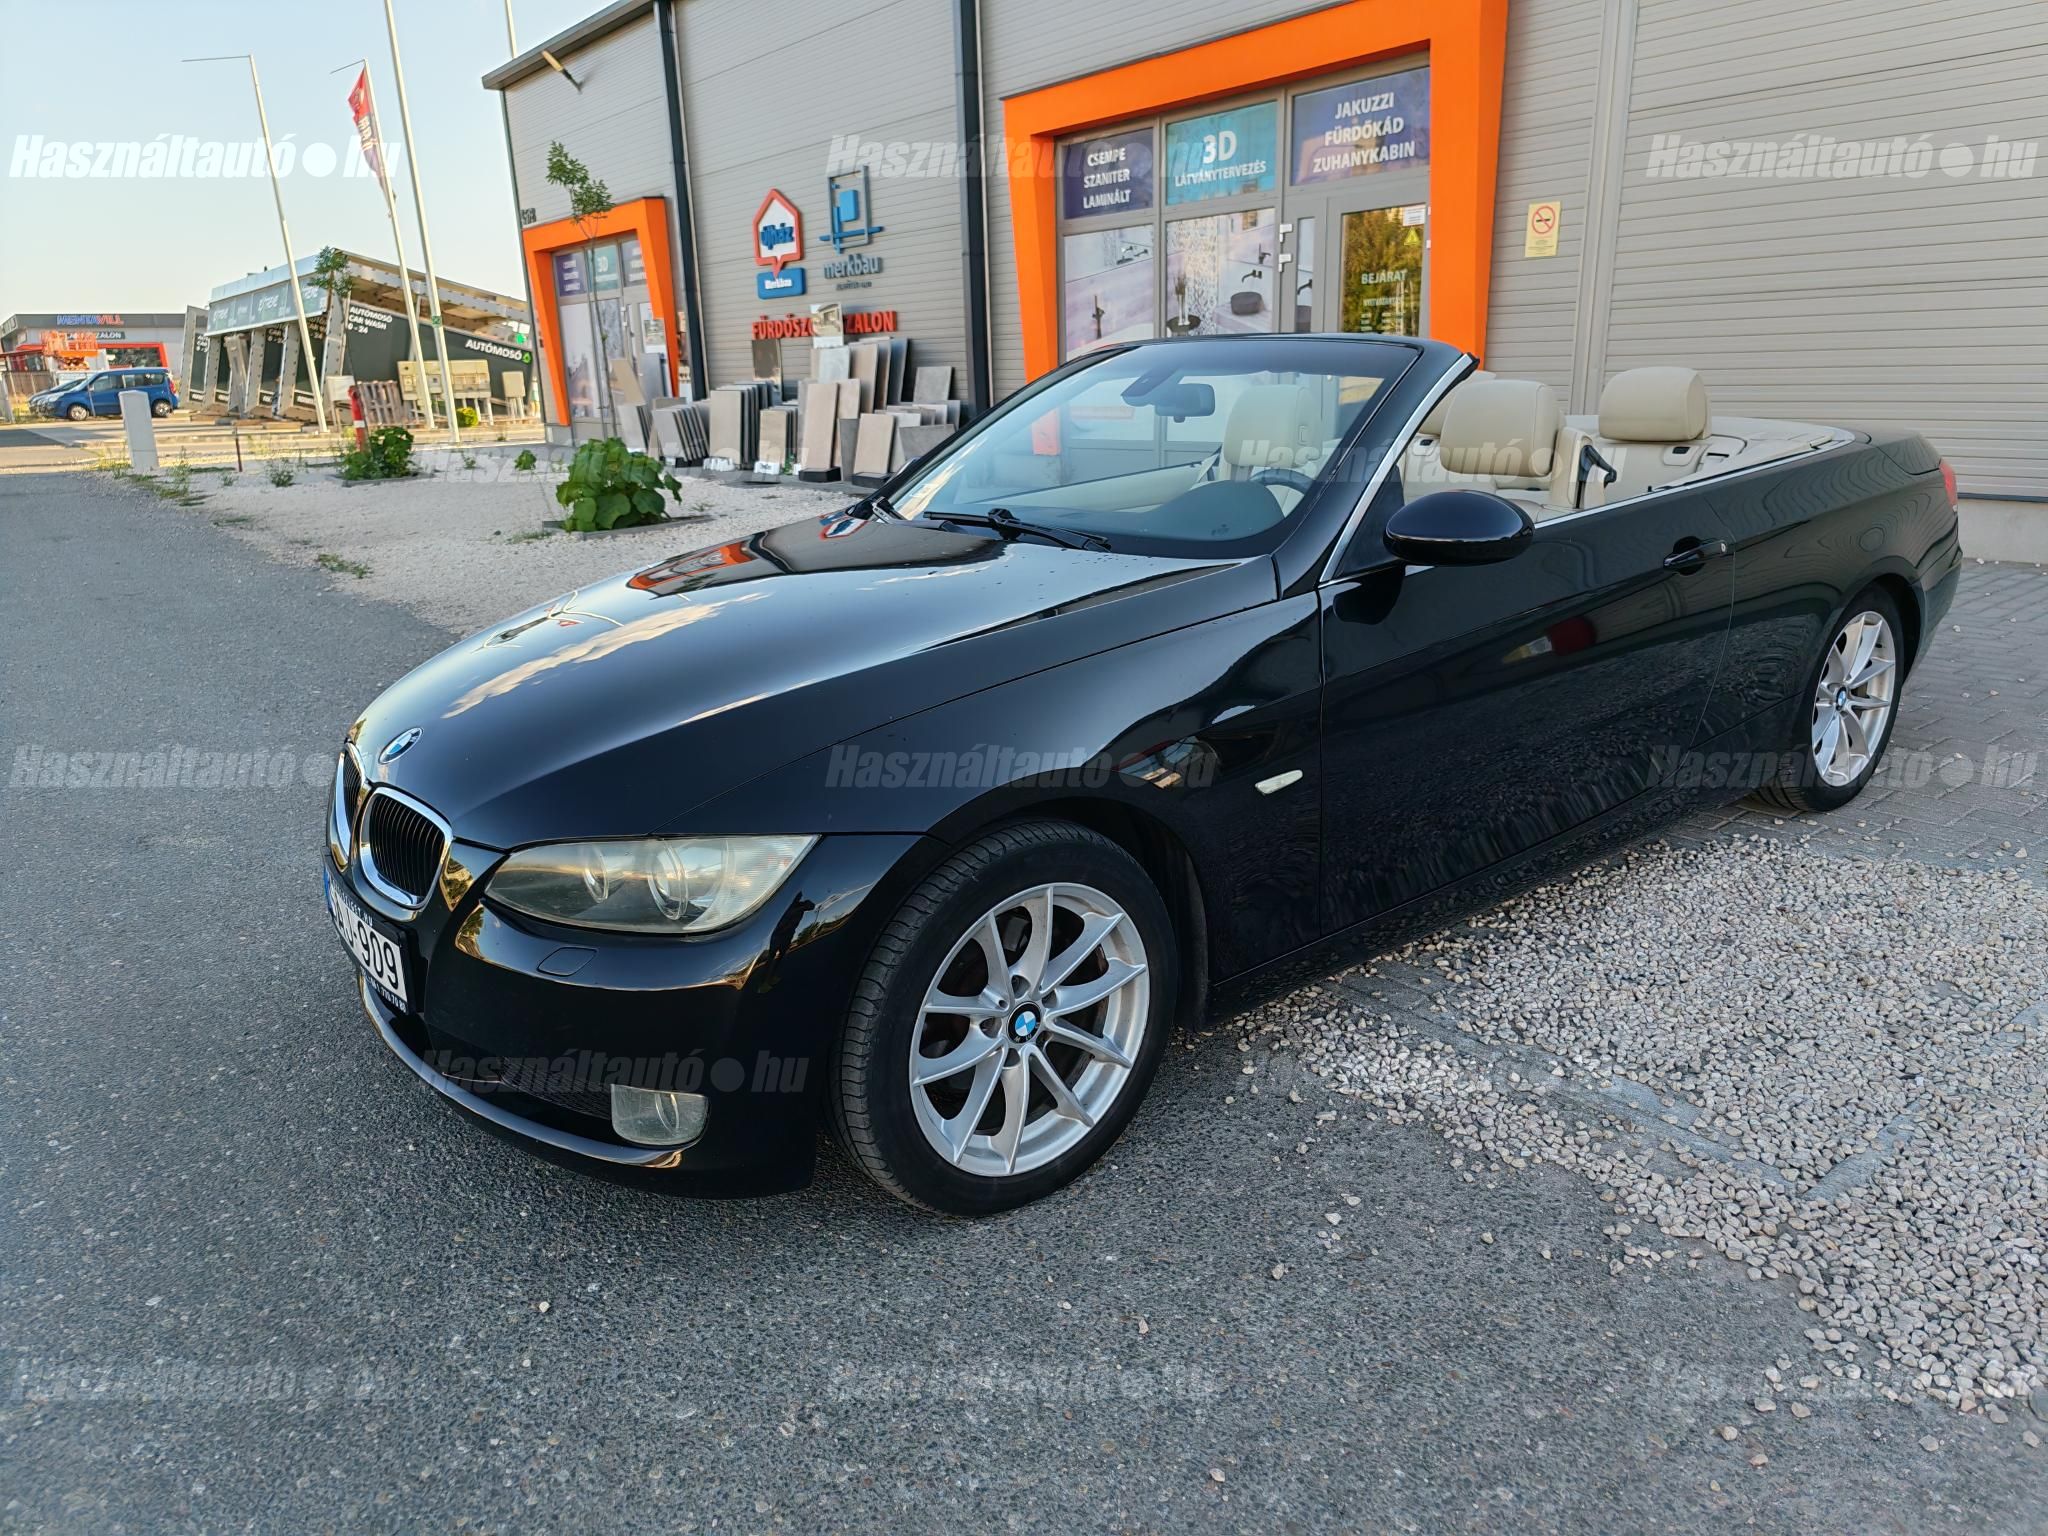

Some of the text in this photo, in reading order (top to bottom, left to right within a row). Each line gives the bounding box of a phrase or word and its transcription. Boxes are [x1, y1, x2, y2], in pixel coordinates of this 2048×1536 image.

[1334, 92, 1394, 119] JAKUZZI
[1324, 115, 1405, 146] FÜRDŐKÁD
[1087, 147, 1126, 167] CSEMPE
[1203, 130, 1237, 164] 3D
[1312, 141, 1416, 173] ZUHANYKABIN
[1083, 168, 1130, 189] SZANITER
[1174, 160, 1267, 187] LÁTVÁNYTERVEZÉS
[1083, 189, 1131, 209] LAMINÁLT
[824, 253, 883, 280] merkbau
[1361, 268, 1408, 285] BEJÁRAT
[844, 310, 898, 334] ZALON
[465, 339, 523, 361] AUTÓMOSÓ
